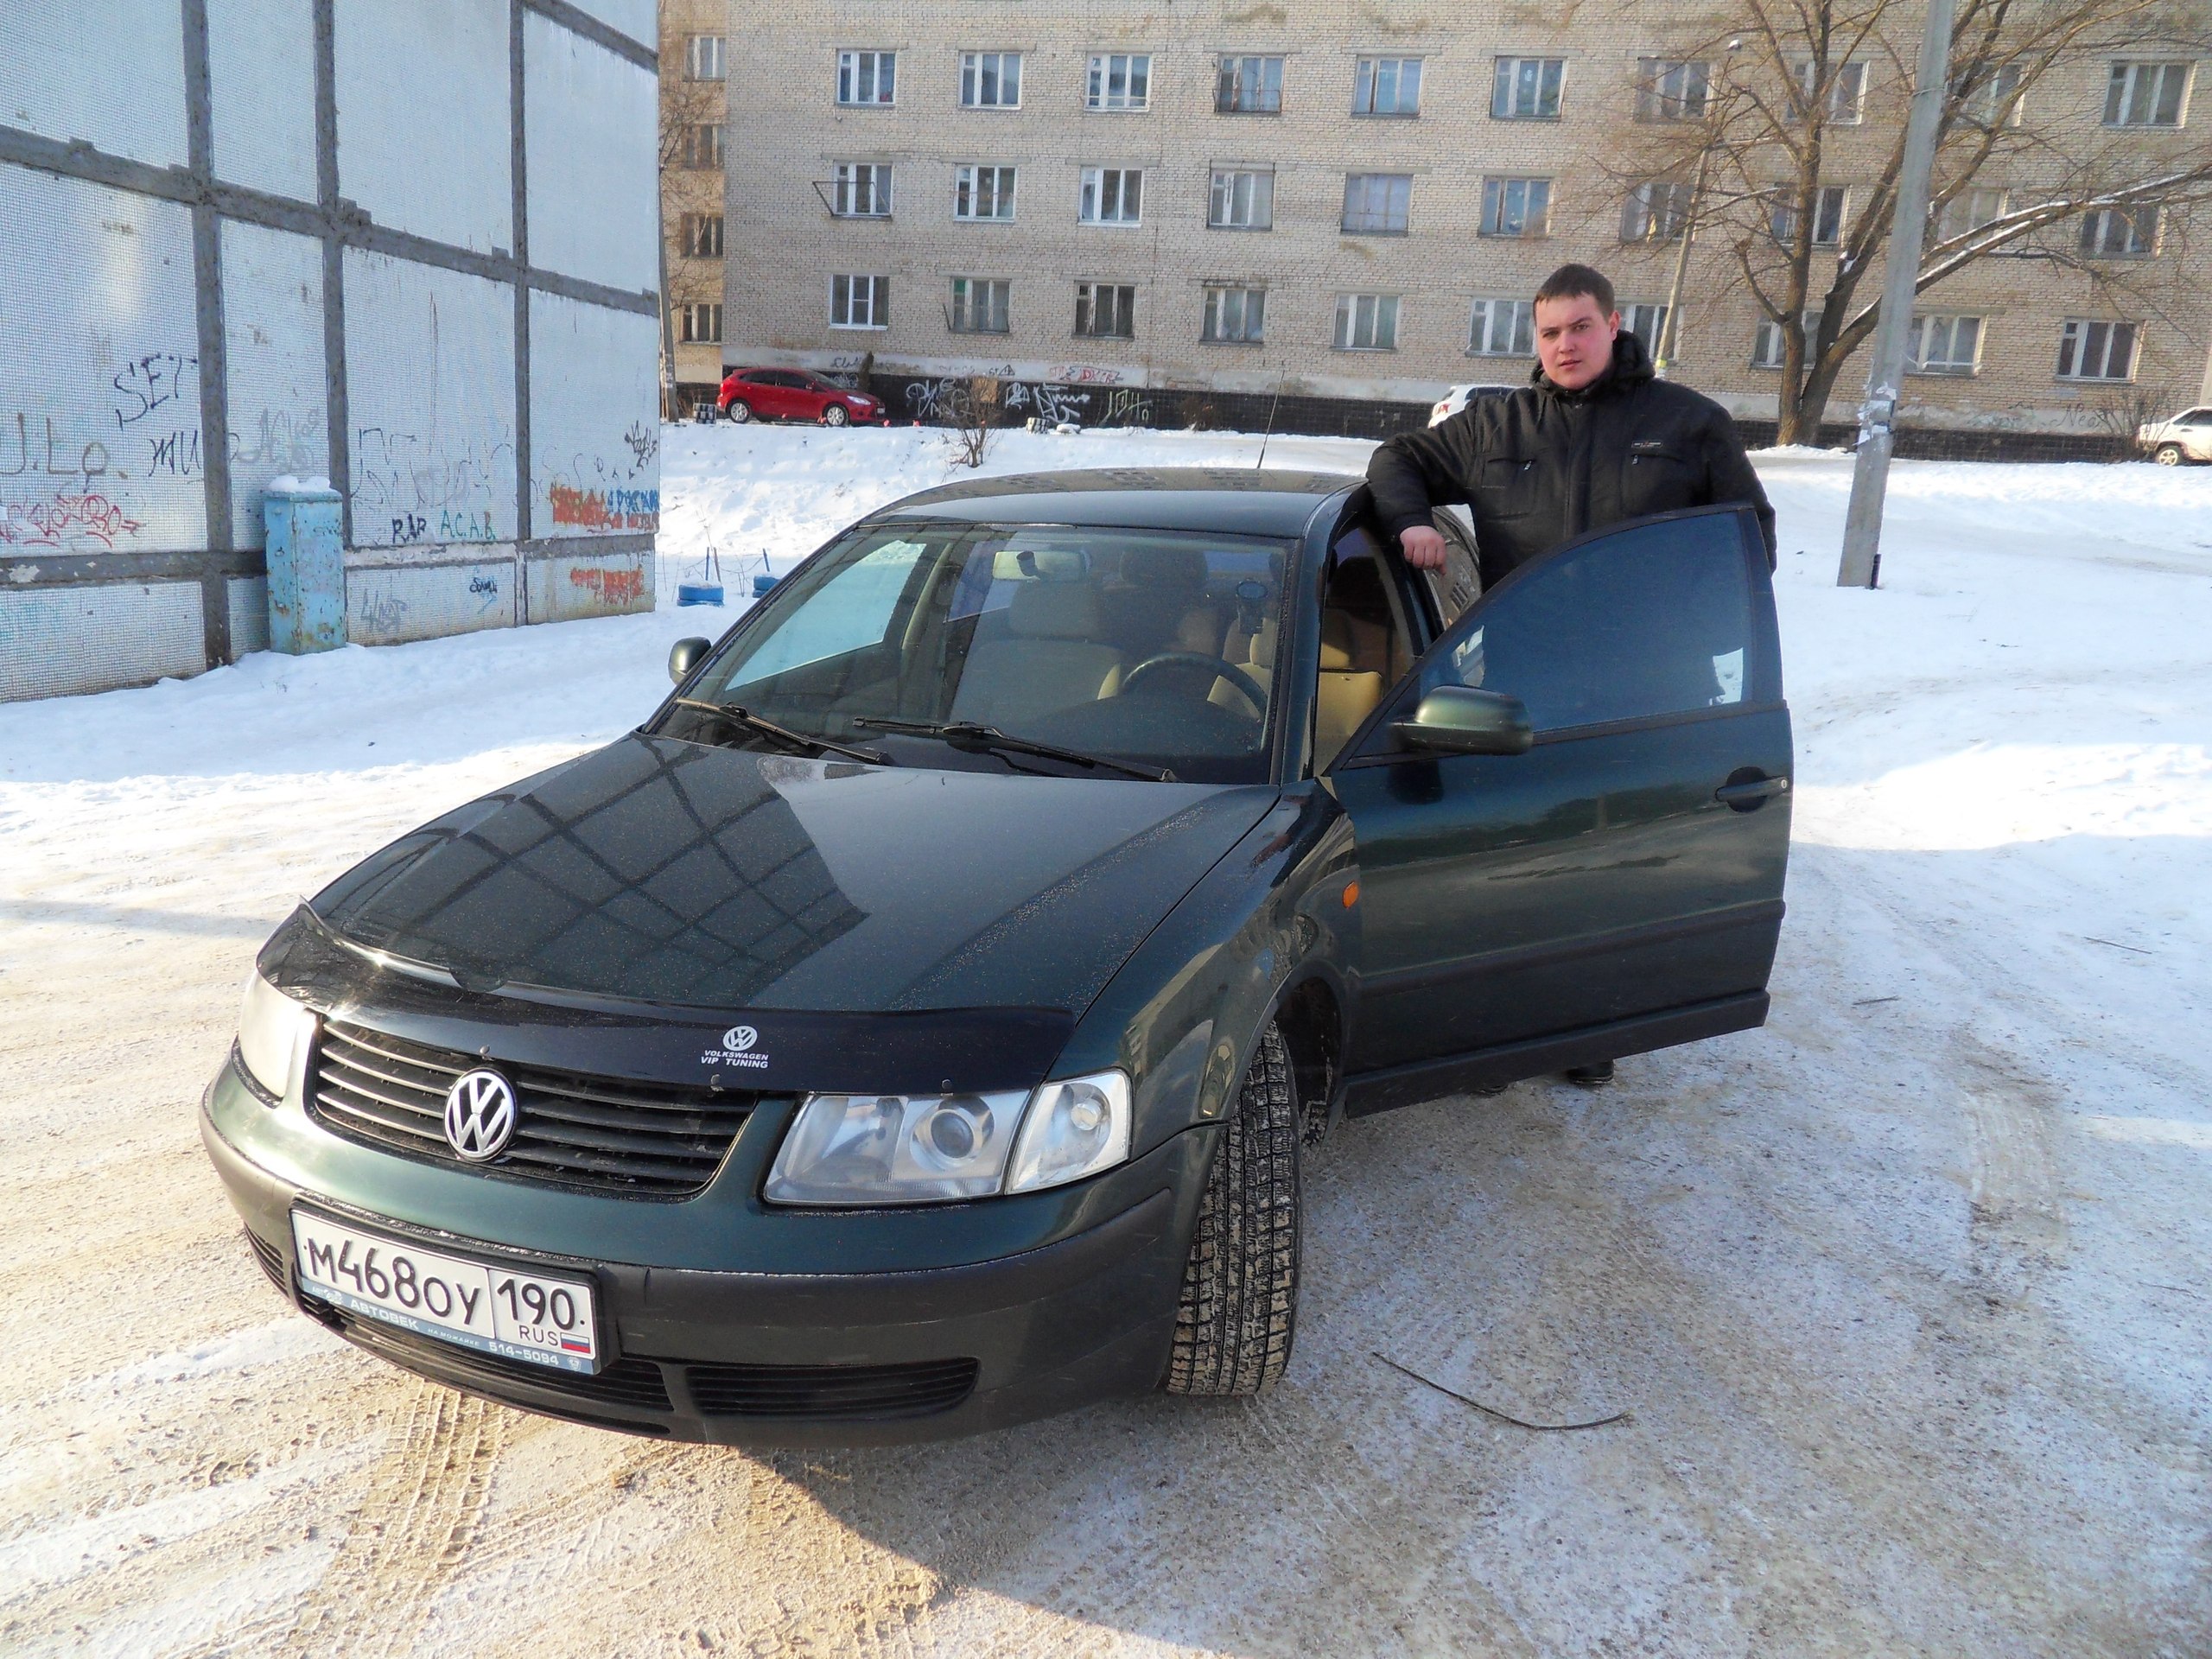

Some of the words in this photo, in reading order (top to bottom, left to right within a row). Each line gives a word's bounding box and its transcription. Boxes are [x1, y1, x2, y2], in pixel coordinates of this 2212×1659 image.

[701, 1056, 719, 1065] VIP
[726, 1058, 768, 1069] TUNING
[704, 1050, 769, 1060] VOLKSWAGEN
[497, 1278, 576, 1331] 190
[350, 1299, 419, 1331] АВТОВЕК
[488, 1341, 560, 1366] 514-5094
[518, 1325, 559, 1346] RUS
